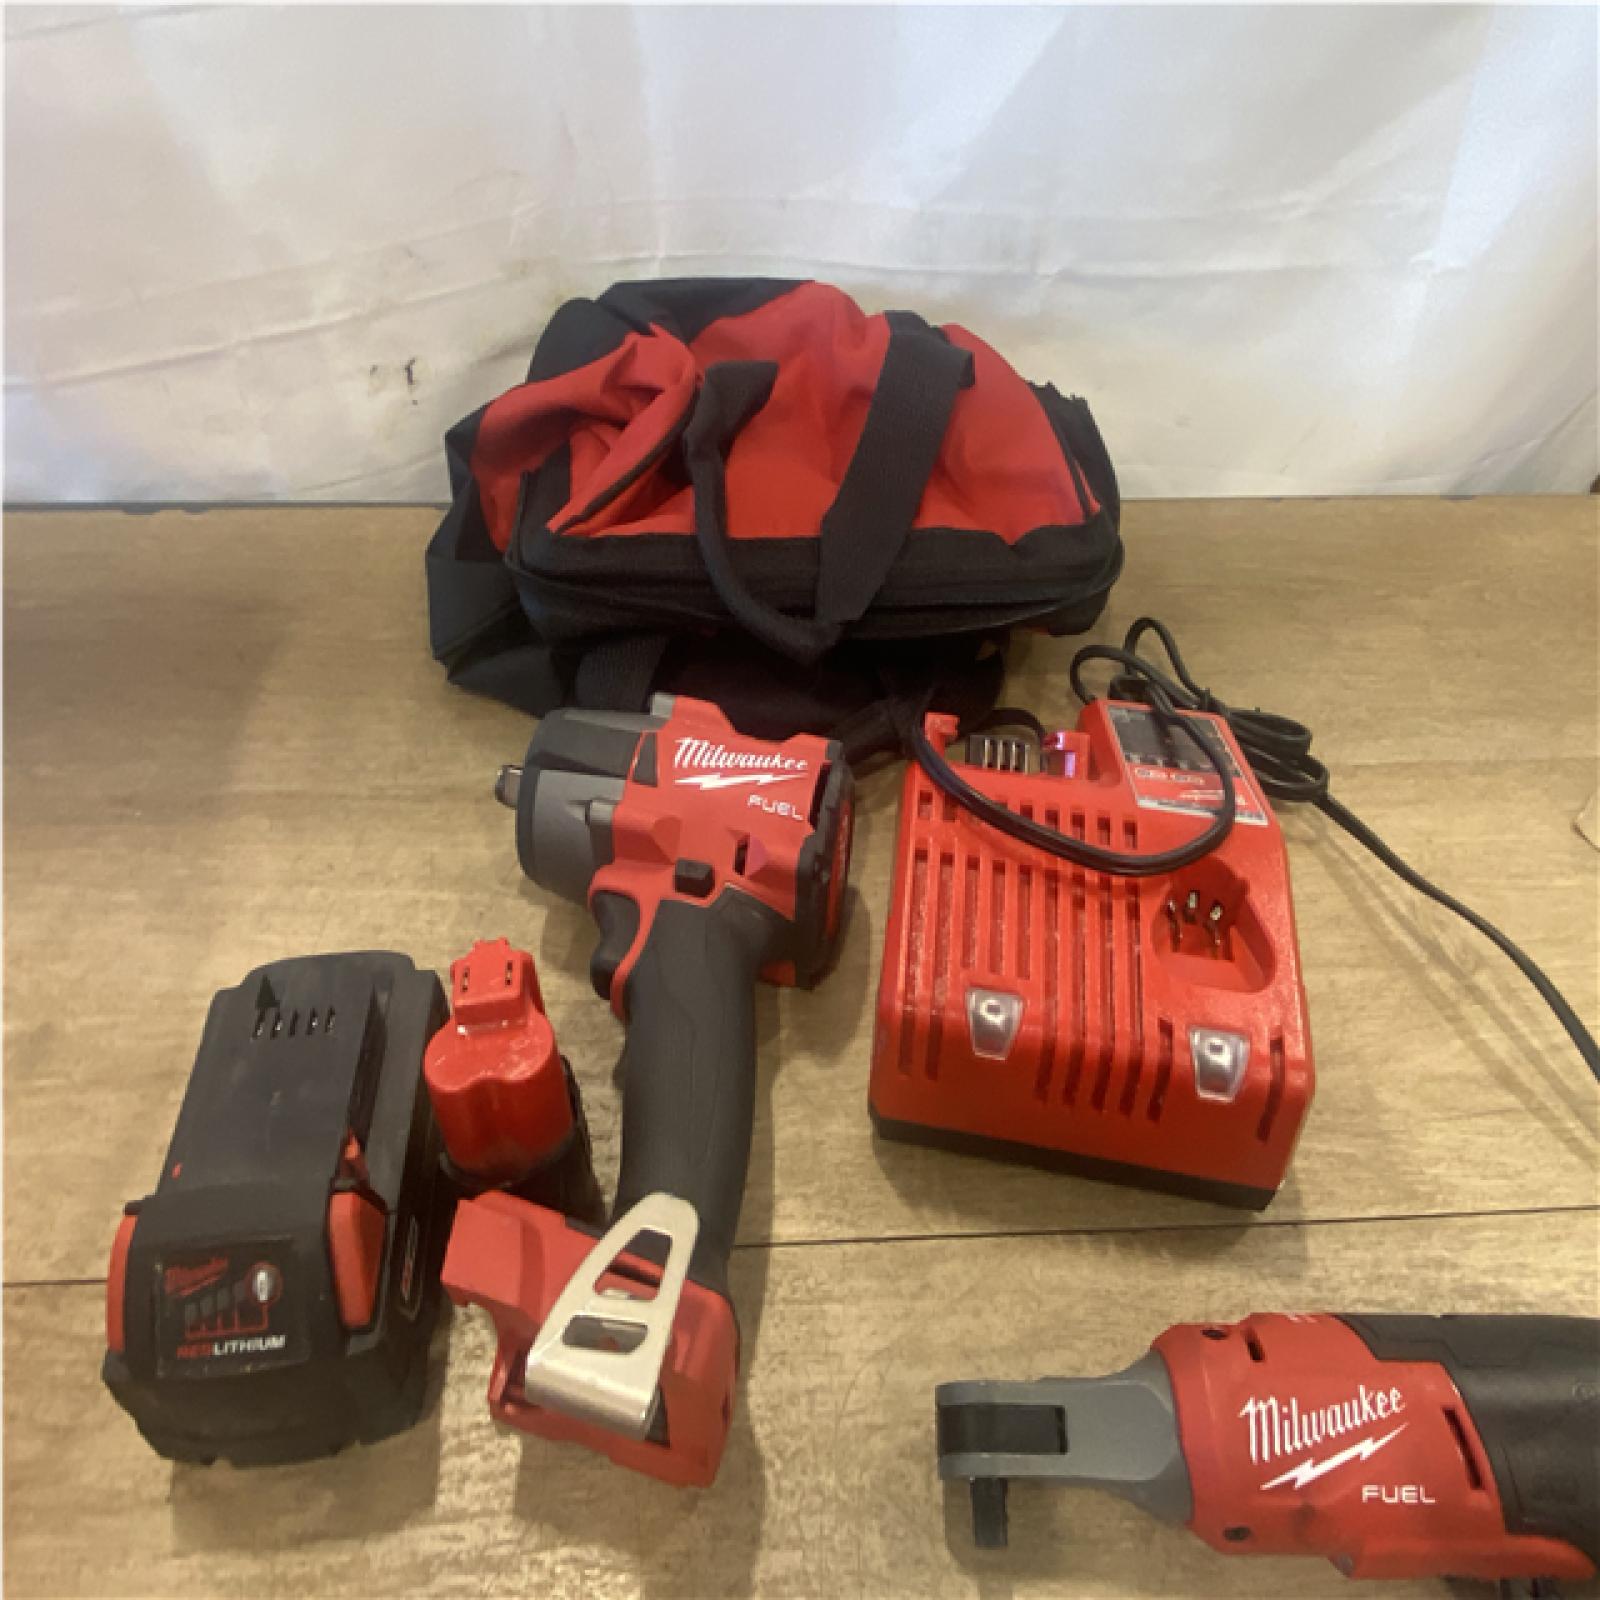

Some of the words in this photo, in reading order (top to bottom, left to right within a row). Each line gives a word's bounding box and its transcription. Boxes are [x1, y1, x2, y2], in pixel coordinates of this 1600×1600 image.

[674, 737, 808, 770] Milwaukee
[747, 795, 803, 820] FUEL
[1238, 1385, 1407, 1464] Milwaukee
[1361, 1485, 1436, 1503] FUEL
